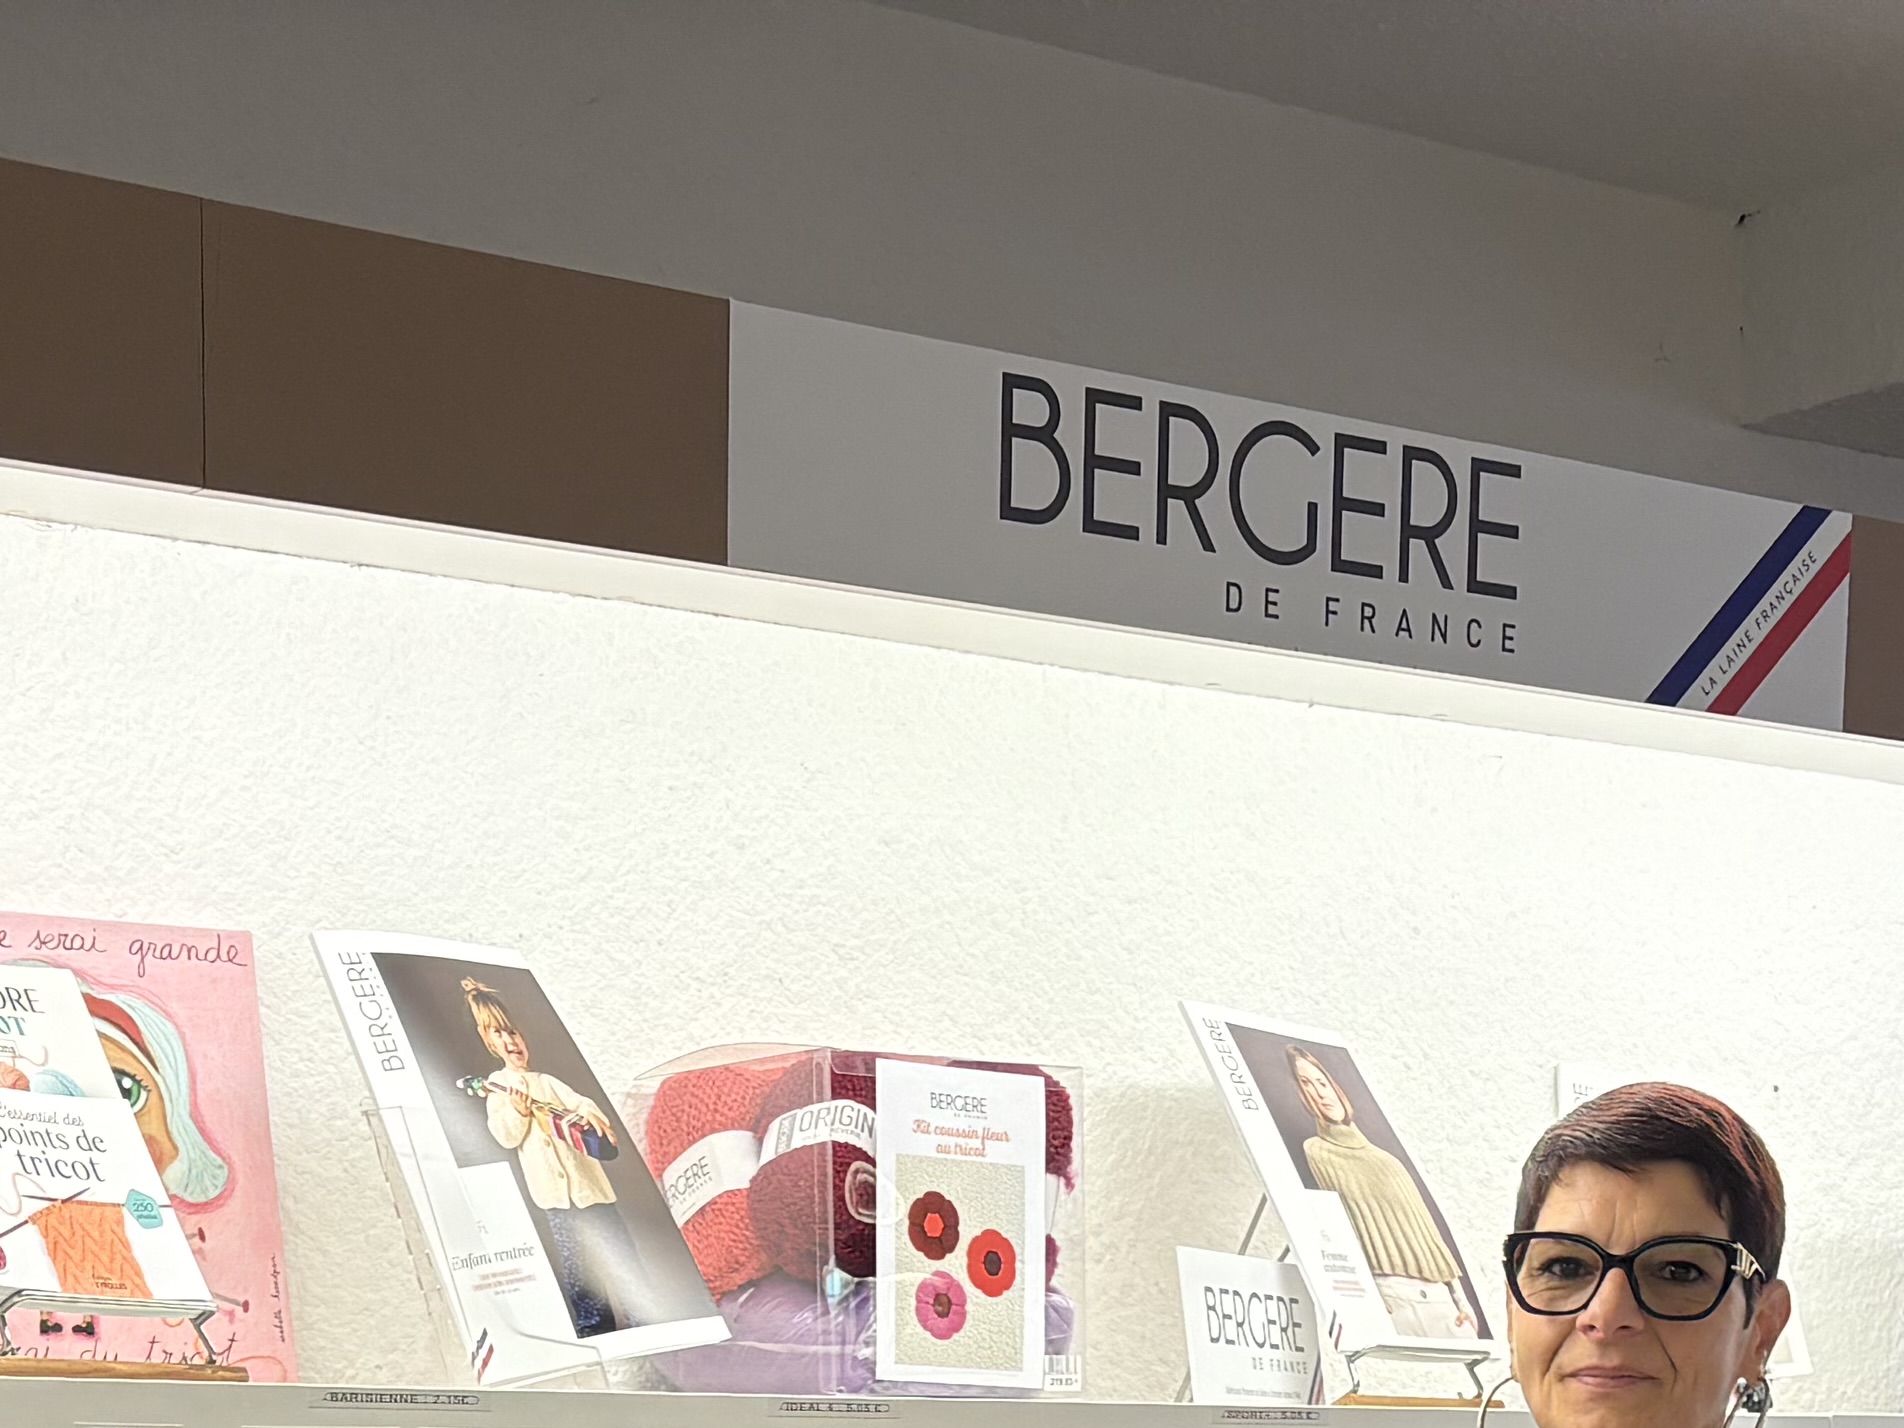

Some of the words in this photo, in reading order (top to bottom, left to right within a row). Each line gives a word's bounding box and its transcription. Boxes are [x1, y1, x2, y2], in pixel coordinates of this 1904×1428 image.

[1000, 371, 1523, 600] BERGERE
[1224, 580, 1283, 622] DE
[1323, 596, 1519, 656] FRANCE
[1700, 677, 1718, 697] LA
[1719, 629, 1754, 676] LAINE
[1754, 551, 1818, 632] FRANÇAISE
[28, 928, 107, 953] serai
[129, 933, 248, 978] grande
[338, 952, 405, 1072] BERGERE
[1203, 1017, 1259, 1111] BERGERE
[929, 1091, 989, 1114] BERGERE
[63, 1112, 85, 1126] des
[912, 1119, 933, 1136] Kit
[934, 1123, 979, 1140] coussin
[981, 1127, 1012, 1149] fleur
[76, 1131, 108, 1153] de
[936, 1144, 954, 1155] au
[955, 1141, 988, 1158] tricot
[16, 1149, 106, 1183] tricot
[133, 1201, 155, 1214] 250
[494, 1242, 535, 1263] rentrée
[1204, 1286, 1305, 1353] BERGERE
[1270, 1358, 1308, 1375] FRANCE
